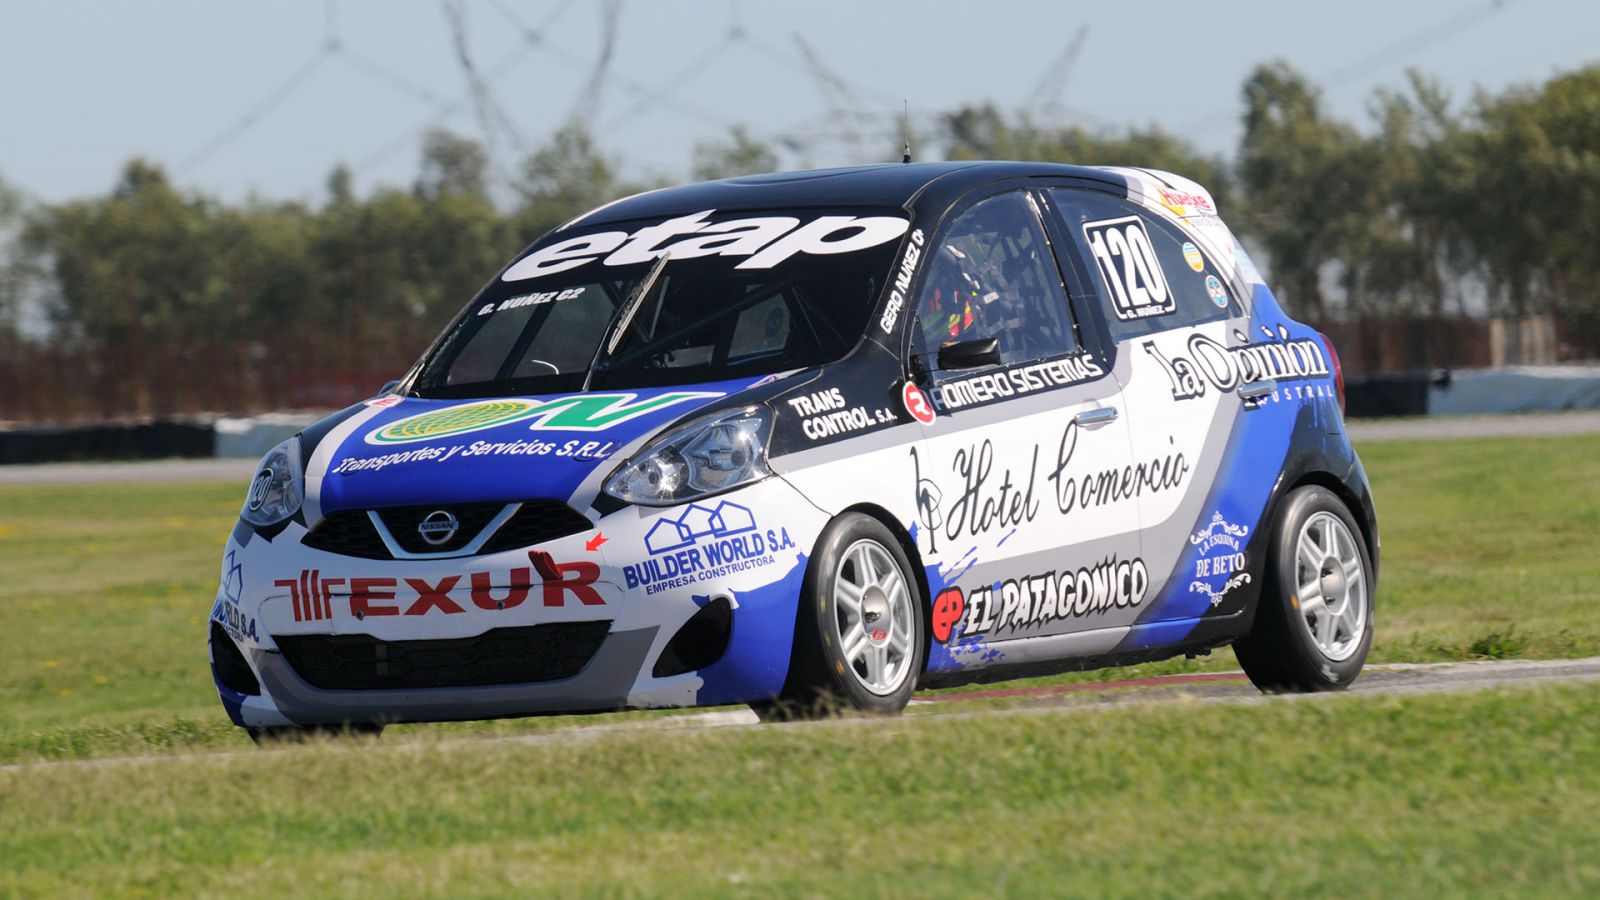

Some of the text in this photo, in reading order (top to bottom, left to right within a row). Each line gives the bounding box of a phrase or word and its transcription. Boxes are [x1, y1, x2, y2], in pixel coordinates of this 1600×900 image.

[501, 208, 910, 282] etap
[1091, 224, 1167, 308] 120
[497, 291, 559, 311] NUÑEZ
[880, 290, 903, 334] GERO
[895, 241, 920, 294] NUÑEZ
[1015, 354, 1104, 394] SISTEMAS
[788, 388, 846, 417] TRANS
[802, 407, 898, 441] CONTROL S.A.
[331, 446, 447, 474] Transportes
[437, 445, 466, 462] y
[461, 438, 557, 457] Servicios
[946, 419, 1189, 541] Hotel Comercio
[420, 521, 454, 531] NISSAN
[623, 526, 796, 590] BUILDER WORLD S.A.
[646, 555, 776, 596] EMPRESA CONSTRUCTORA
[1195, 552, 1246, 578] DE BETO
[959, 555, 1148, 638] EL PATAGONICO
